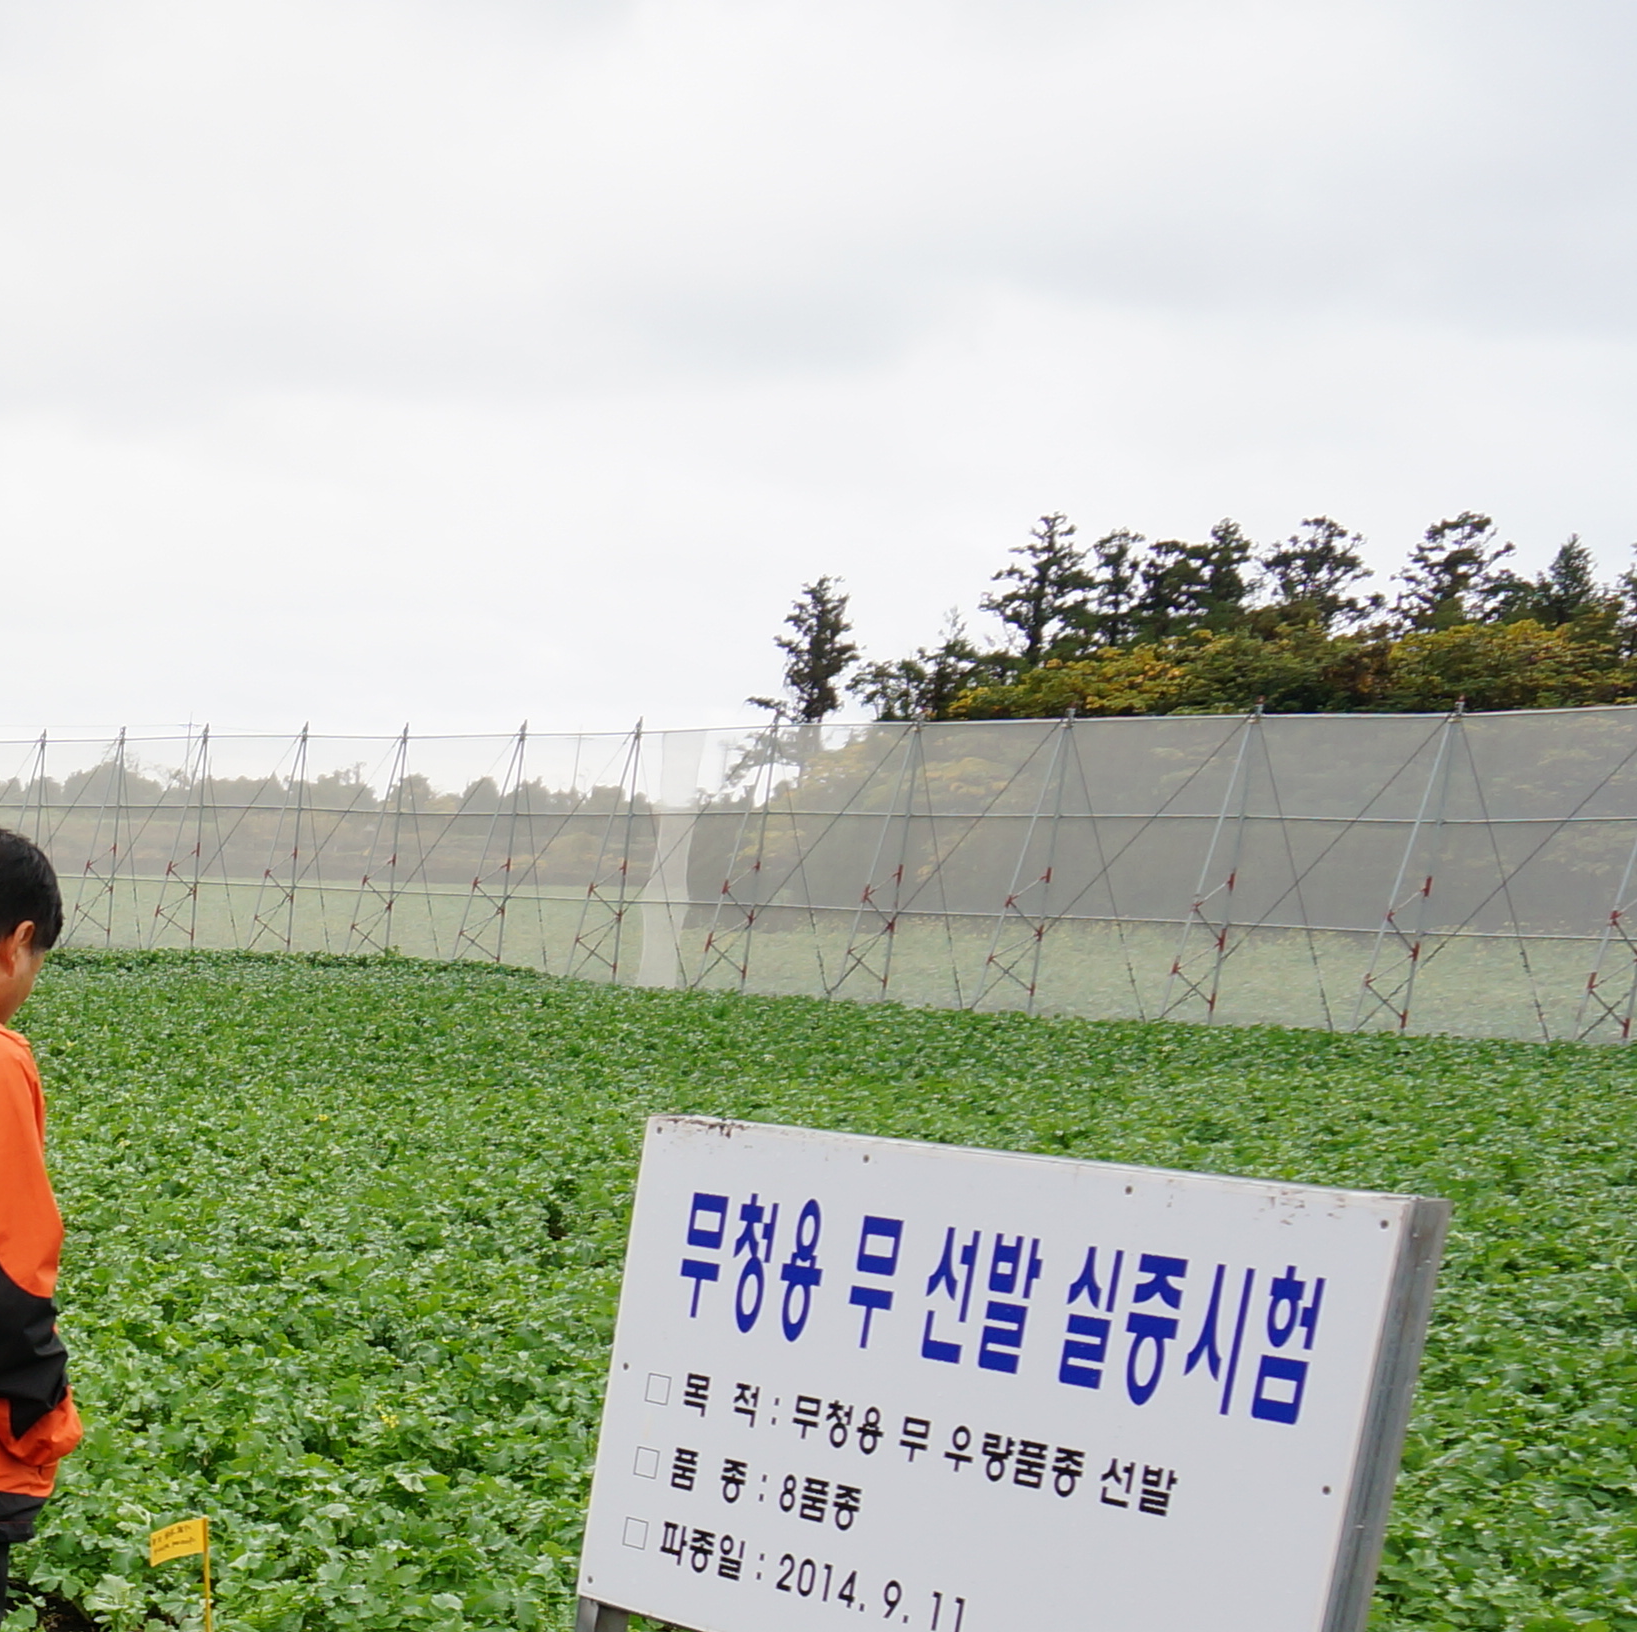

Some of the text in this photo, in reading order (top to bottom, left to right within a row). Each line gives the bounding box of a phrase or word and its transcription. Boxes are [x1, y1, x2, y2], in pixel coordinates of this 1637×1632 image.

[680, 1192, 1326, 1425] 무청용 무 선발 실증시험
[671, 1447, 699, 1492] 품
[779, 1474, 862, 1531] 8품종
[683, 1373, 710, 1417] 목
[792, 1394, 884, 1455] 무청용
[899, 1416, 931, 1462] 무
[943, 1425, 1086, 1497] 우량품종
[1100, 1458, 1179, 1517] 선발
[660, 1521, 746, 1581] 파종일
